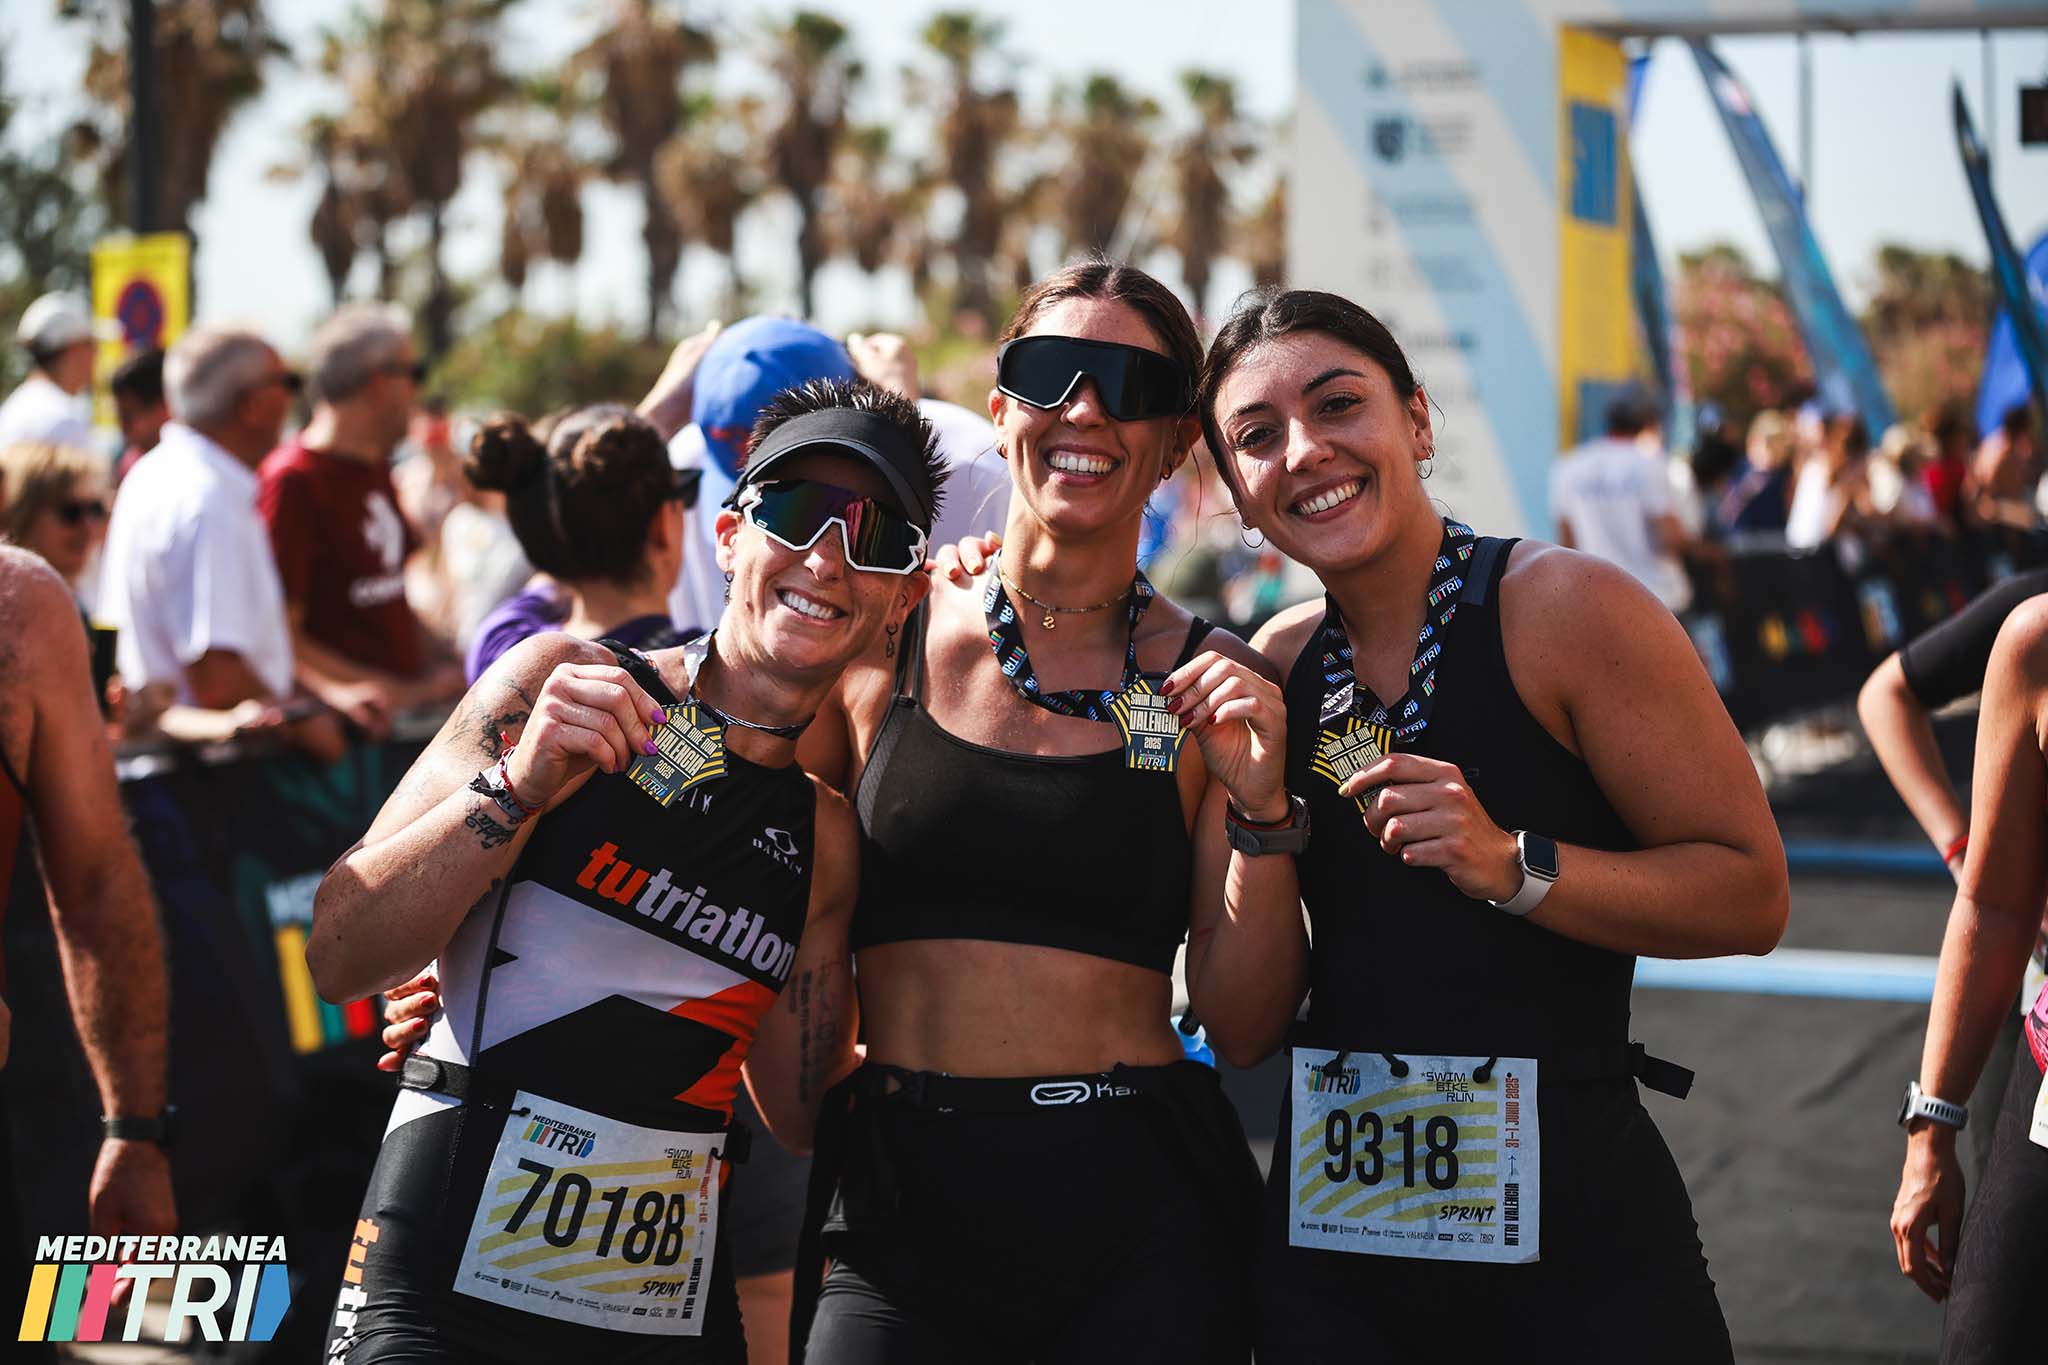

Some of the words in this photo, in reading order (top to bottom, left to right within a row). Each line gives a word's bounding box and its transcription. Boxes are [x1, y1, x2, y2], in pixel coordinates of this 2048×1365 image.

[670, 712, 693, 735] SWIM
[1144, 737, 1161, 749] 2025
[654, 759, 675, 780] 2025
[575, 841, 796, 982] tutriatlon
[1096, 1083, 1136, 1098] Ka
[1436, 1082, 1468, 1092] BIKE
[1446, 1092, 1474, 1103] RUN
[1505, 1077, 1519, 1099] 2025
[532, 1114, 597, 1140] MEDITERRANEA
[1324, 1109, 1459, 1190] 9318
[503, 1158, 685, 1266] 7018B
[1439, 1205, 1495, 1223] SPRINT
[639, 1280, 685, 1298] SPRINT
